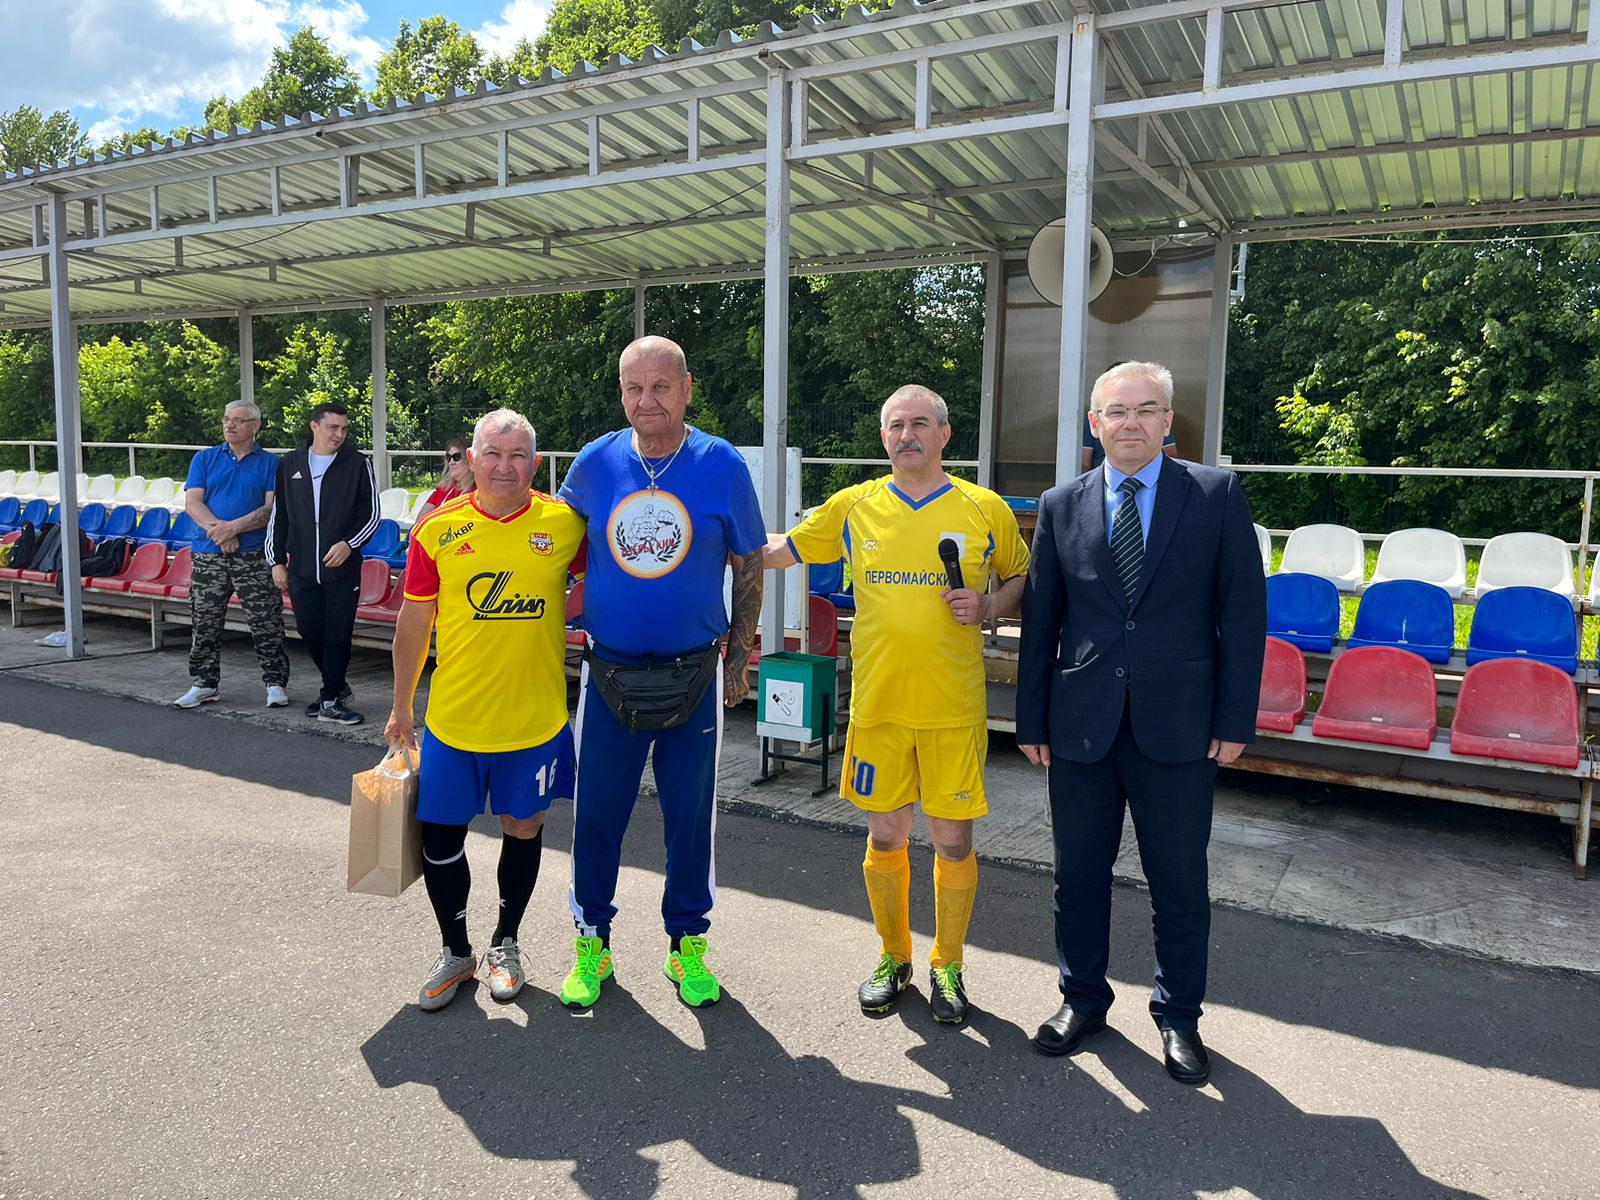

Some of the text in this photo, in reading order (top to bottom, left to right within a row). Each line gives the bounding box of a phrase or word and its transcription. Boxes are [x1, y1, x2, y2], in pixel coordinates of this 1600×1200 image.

[454, 522, 474, 538] KBP
[865, 569, 951, 586] ПЕРВОМАЙСКИ
[535, 757, 558, 796] 16
